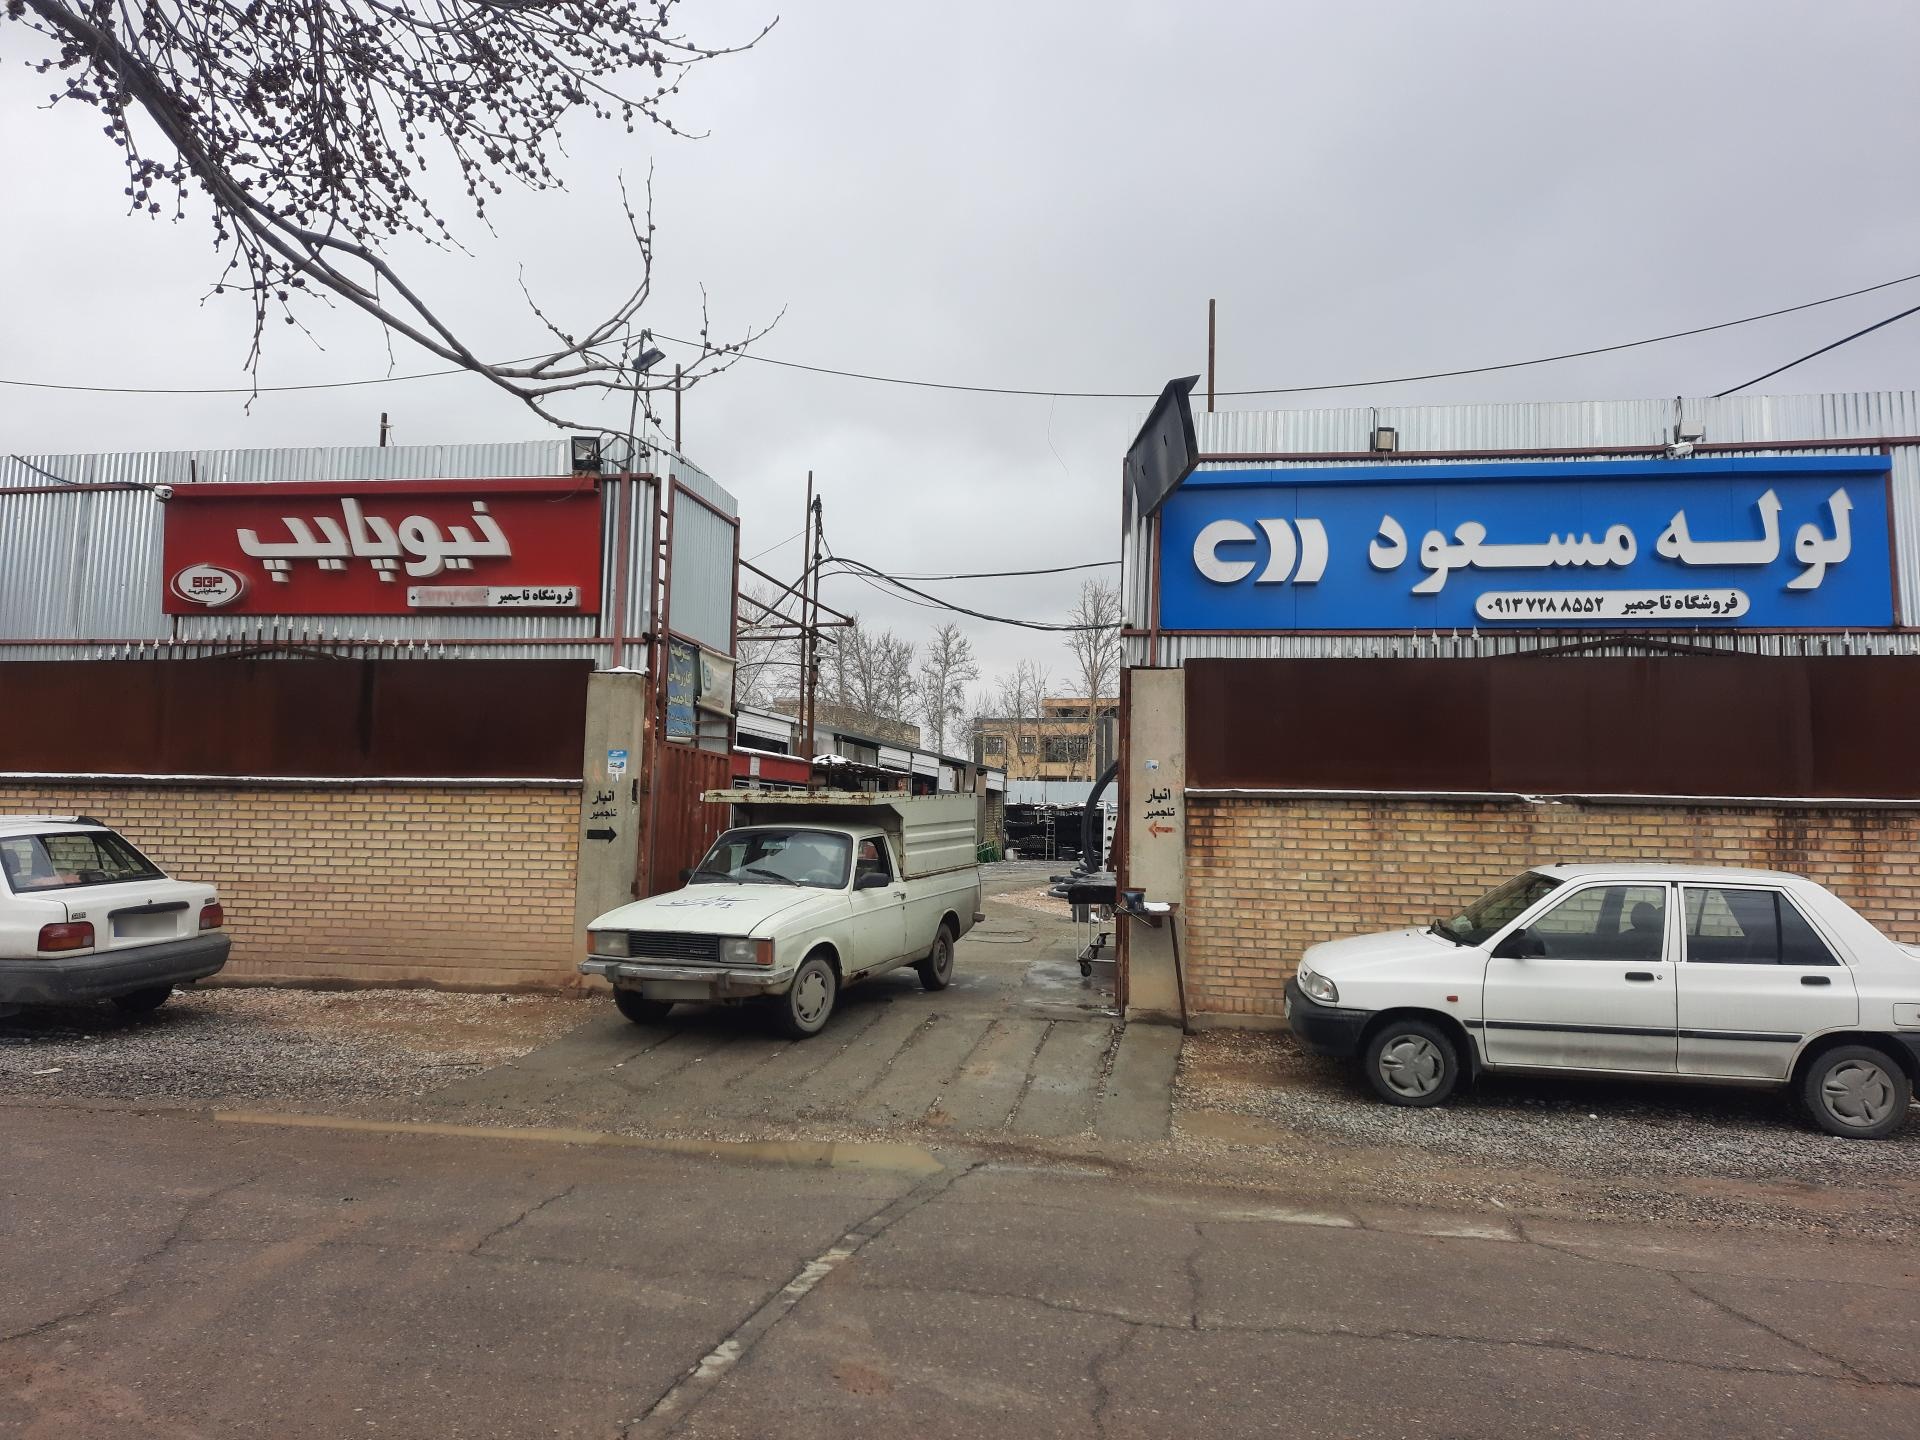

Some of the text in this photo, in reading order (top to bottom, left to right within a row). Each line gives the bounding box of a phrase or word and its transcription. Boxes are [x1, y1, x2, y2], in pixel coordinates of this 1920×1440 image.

[1369, 486, 1855, 594] لوله مسعود
[497, 588, 530, 605] تاجمیر
[532, 587, 574, 605] فروشگاه
[1621, 594, 1672, 615] تاجمیر
[1674, 592, 1738, 615] فروشگاه
[592, 790, 615, 805] انبار
[1145, 787, 1171, 804] انبار
[589, 808, 617, 820] تاجمیر
[1143, 807, 1176, 820] تاجمیر
